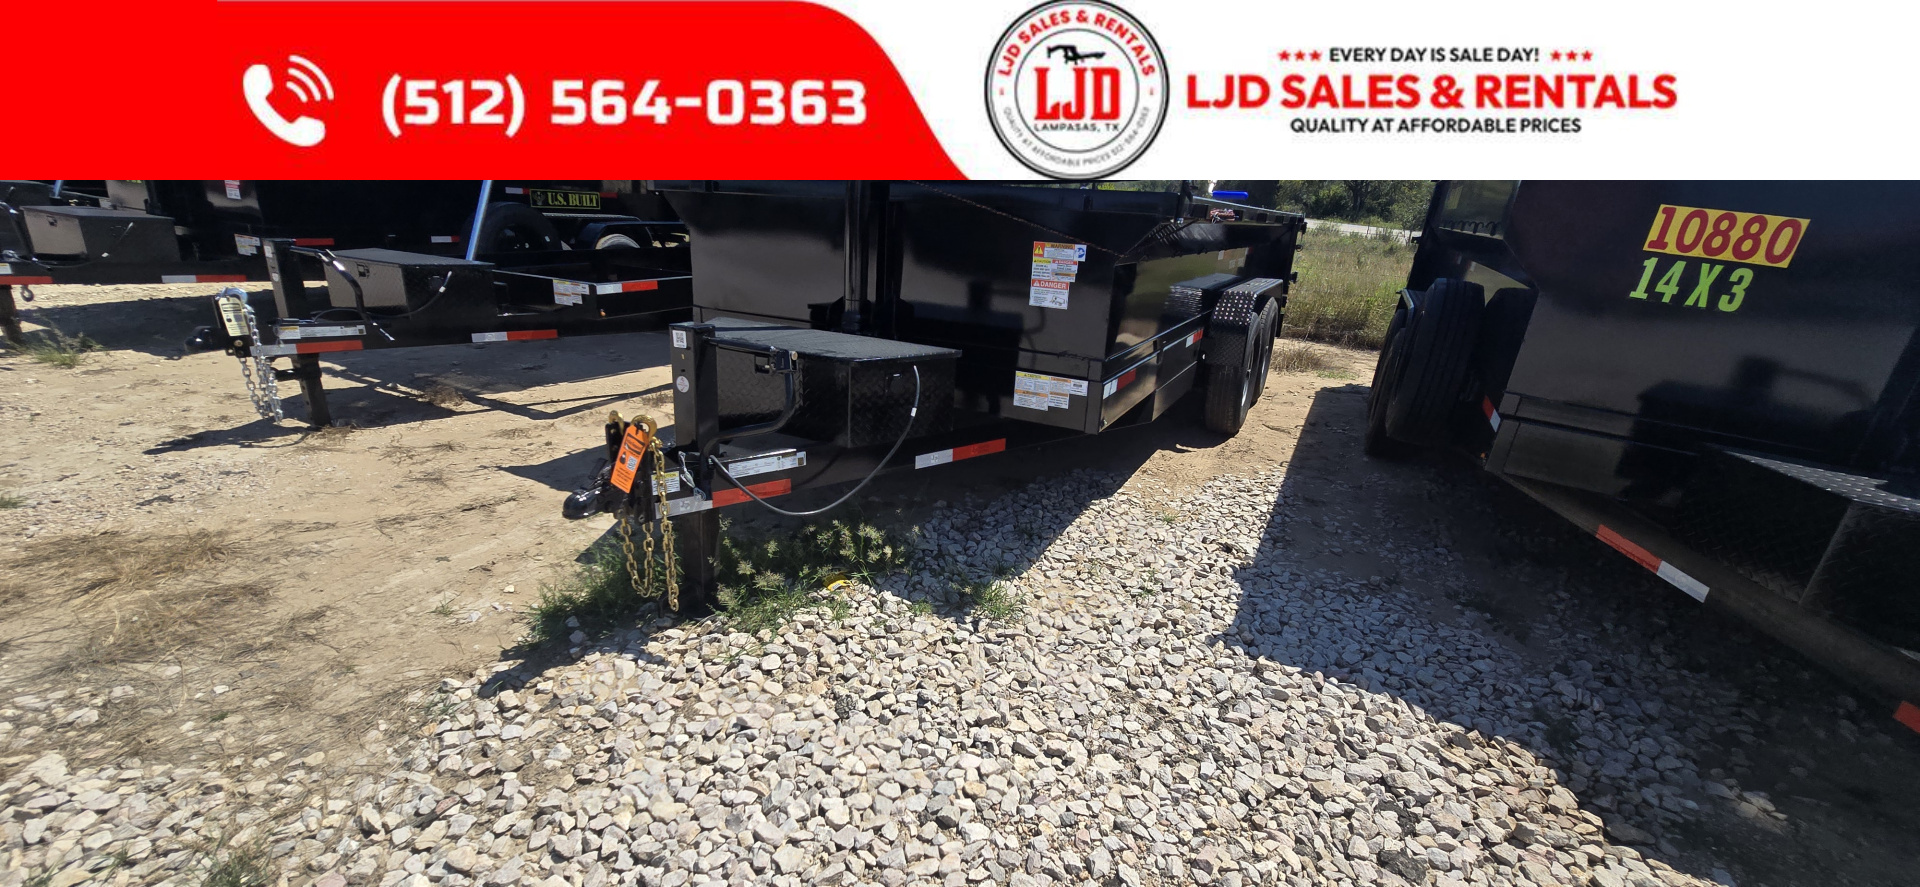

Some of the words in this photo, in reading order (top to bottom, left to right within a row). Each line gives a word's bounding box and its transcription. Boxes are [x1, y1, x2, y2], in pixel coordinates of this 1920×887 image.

[547, 192, 567, 205] U.S.
[568, 193, 598, 207] BUILT
[1647, 206, 1803, 264] 10880
